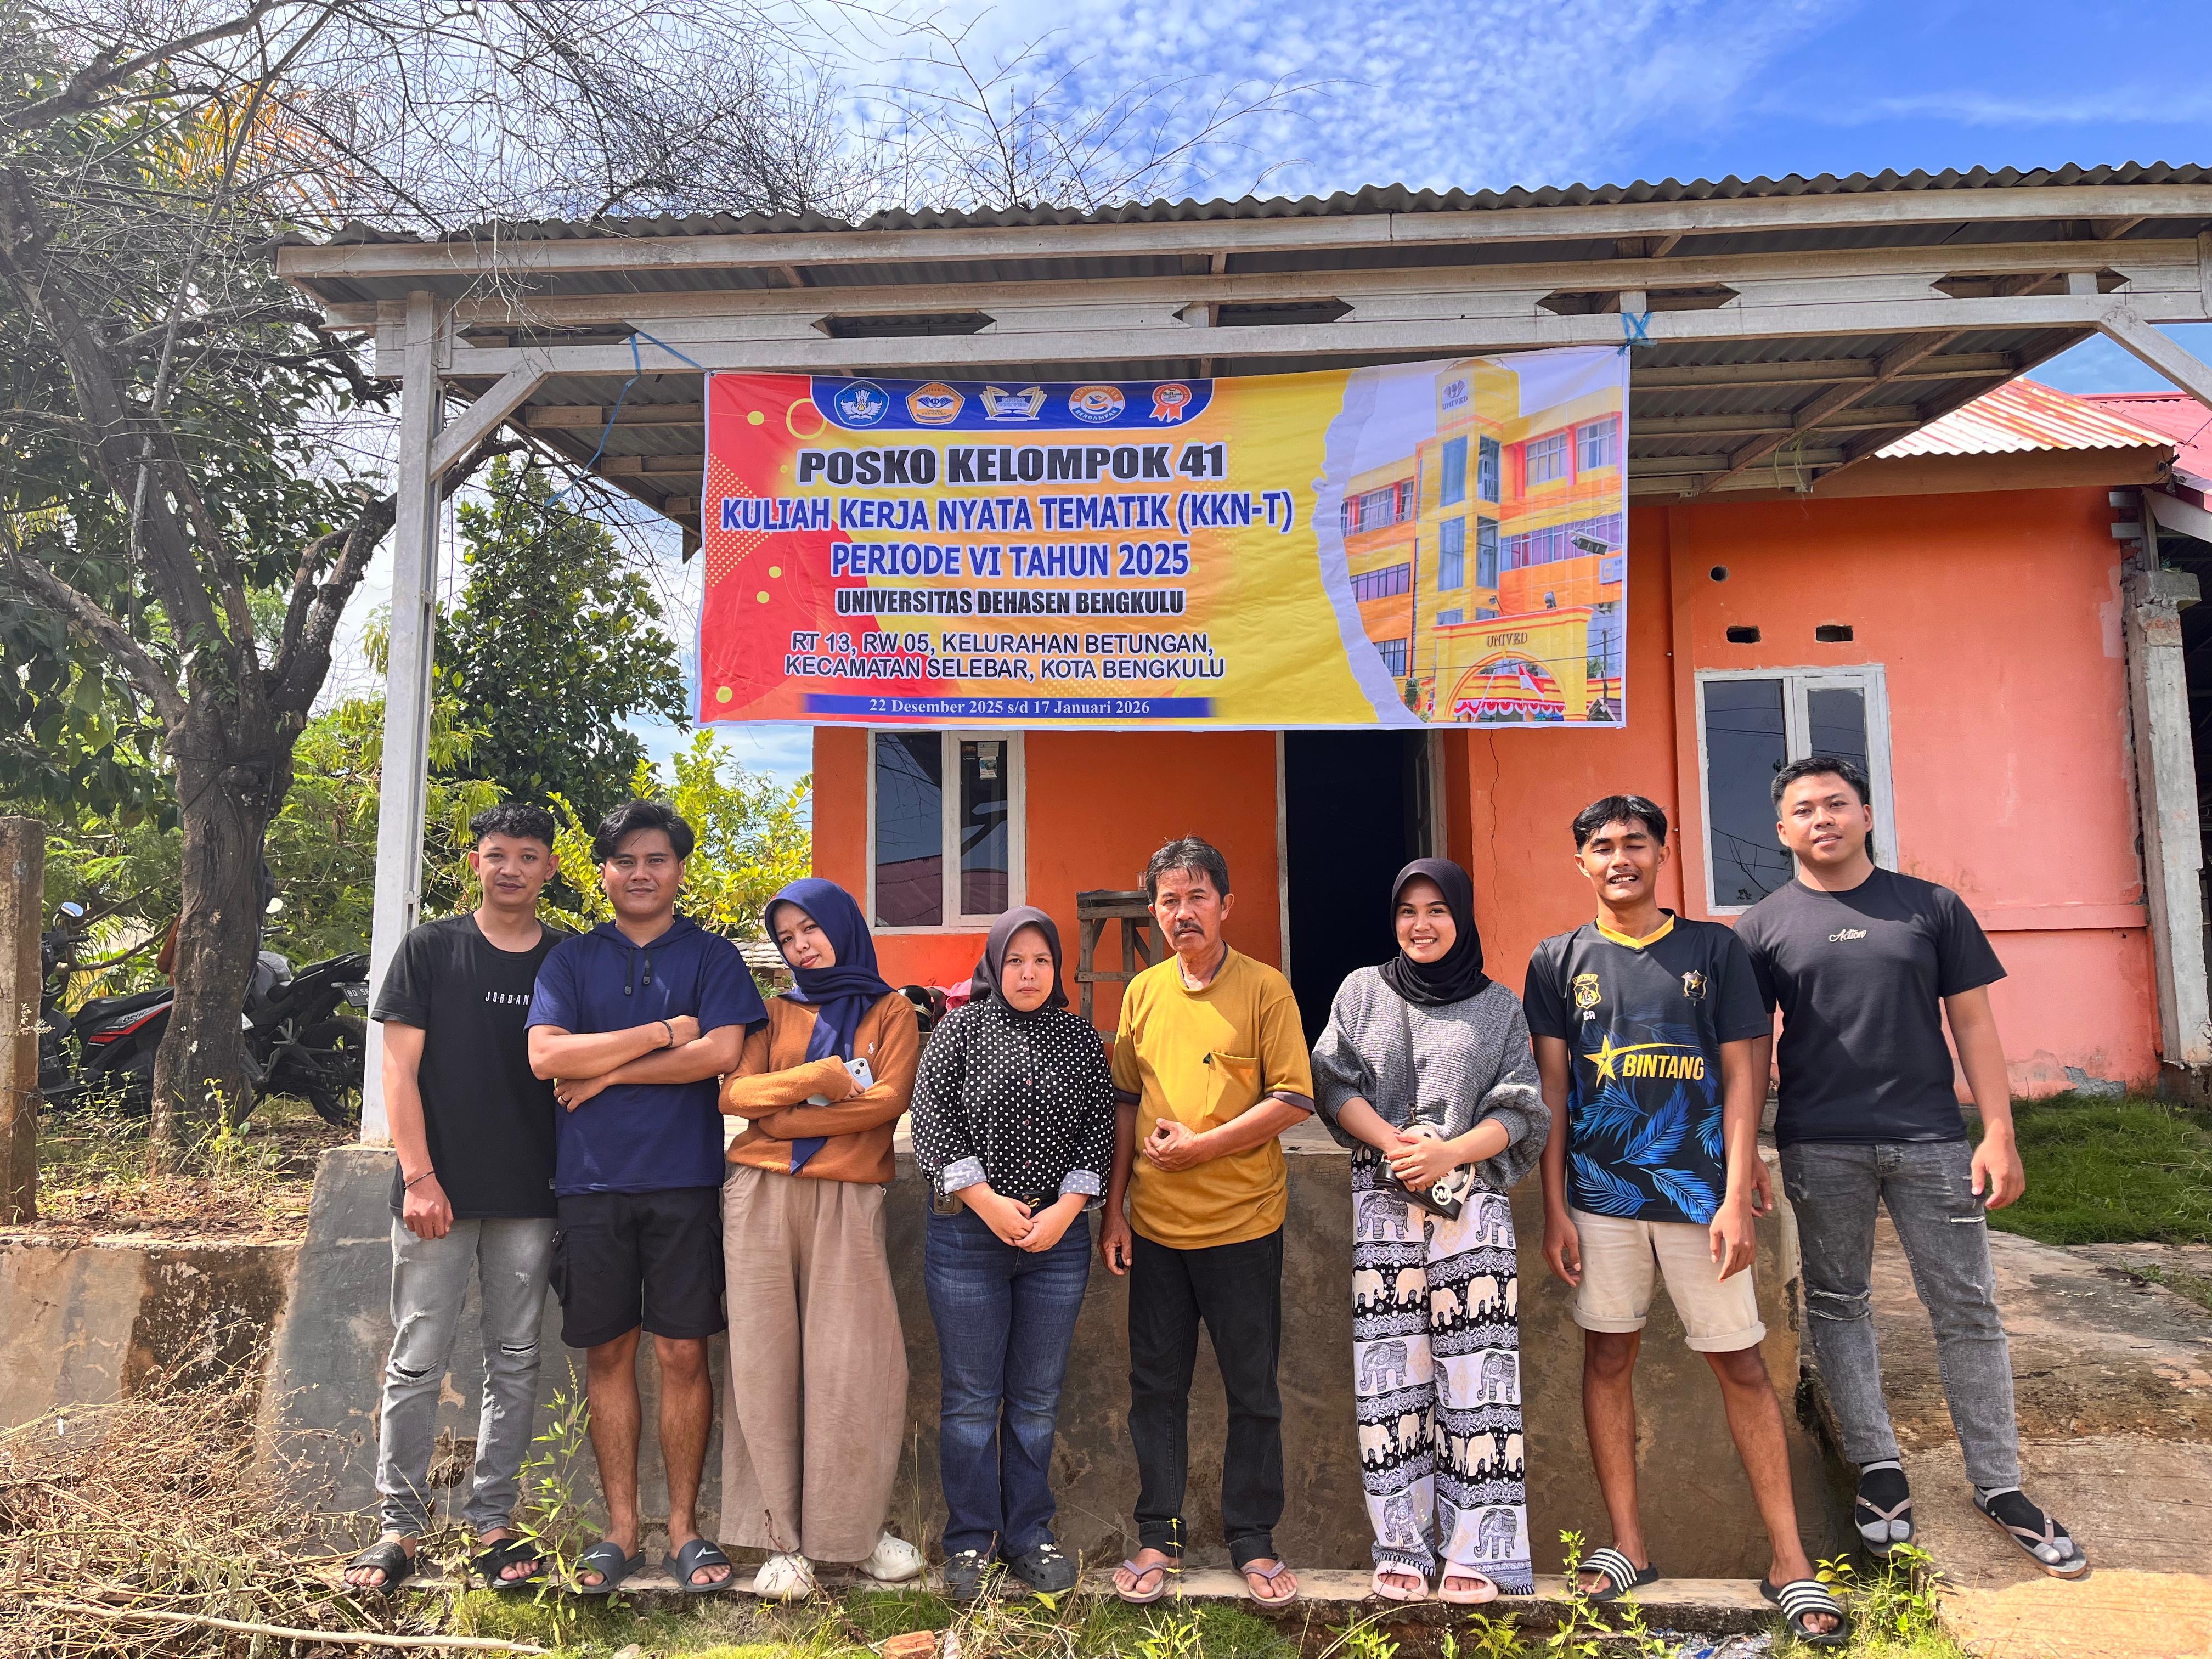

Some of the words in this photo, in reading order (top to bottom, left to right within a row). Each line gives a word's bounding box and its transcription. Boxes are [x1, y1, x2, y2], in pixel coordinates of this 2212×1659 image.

[1075, 409, 1119, 421] BERDAMPAK
[799, 449, 936, 485] POSKO
[948, 446, 1170, 483] KELOMPOK
[1179, 445, 1223, 477] 41
[723, 499, 830, 530] KULIAH
[840, 499, 929, 531] KERJA
[939, 498, 1032, 531] NYATA
[1040, 495, 1170, 529] TEMATIK
[1178, 491, 1292, 534] (KKN-T)
[833, 544, 960, 575] PERIODE
[968, 546, 1001, 575] VI
[1009, 545, 1108, 577] TAHUN
[1119, 543, 1188, 575] 2025
[838, 590, 972, 614] UNIVERSITAS
[978, 591, 1070, 614] DEHASEN
[1076, 591, 1183, 614] BENGKULU
[793, 633, 820, 651] RT
[826, 634, 856, 656] 13,
[864, 633, 898, 652] RW
[904, 633, 935, 656] 05,
[943, 633, 1077, 654] KELURAHAN
[1085, 634, 1213, 657] BETUNGAN,
[1487, 632, 1528, 647] UNIVED
[786, 655, 920, 678] KECAMATAN
[927, 658, 1034, 682] SELEBAR,
[1041, 659, 1096, 678] KOTA
[1103, 658, 1224, 679] BENGKULU
[869, 699, 887, 712] 22
[891, 699, 966, 713] Desember
[969, 700, 1003, 713] 2025
[1007, 701, 1029, 714] s/d
[1034, 701, 1050, 714] 17
[1054, 701, 1111, 714] Januari
[1115, 701, 1150, 714] 2026
[1829, 929, 1867, 943] Action
[485, 991, 529, 1005] JORDAN
[1622, 1054, 1705, 1081] BINTANG
